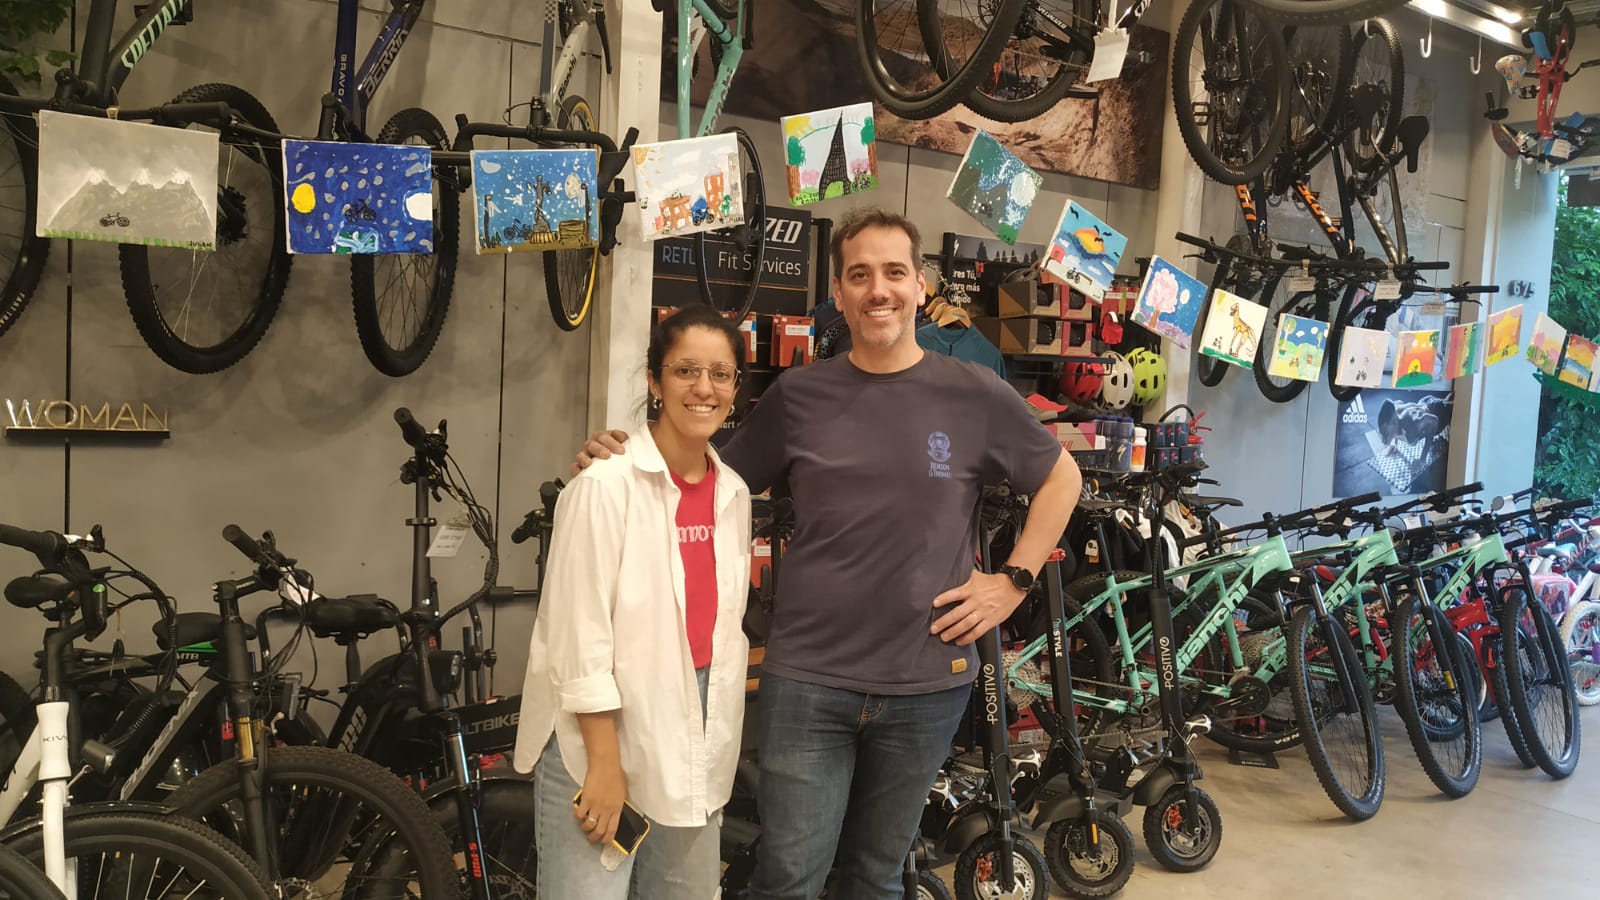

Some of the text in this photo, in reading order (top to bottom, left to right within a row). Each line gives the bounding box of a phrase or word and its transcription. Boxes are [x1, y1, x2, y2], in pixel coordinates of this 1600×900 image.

[338, 53, 347, 97] BRAVO
[718, 251, 801, 275] Fit Srvices
[6, 399, 168, 430] WOMAN
[1342, 412, 1368, 424] adidas
[1160, 636, 1175, 690] POSITIVO
[983, 663, 999, 725] POSITIVO
